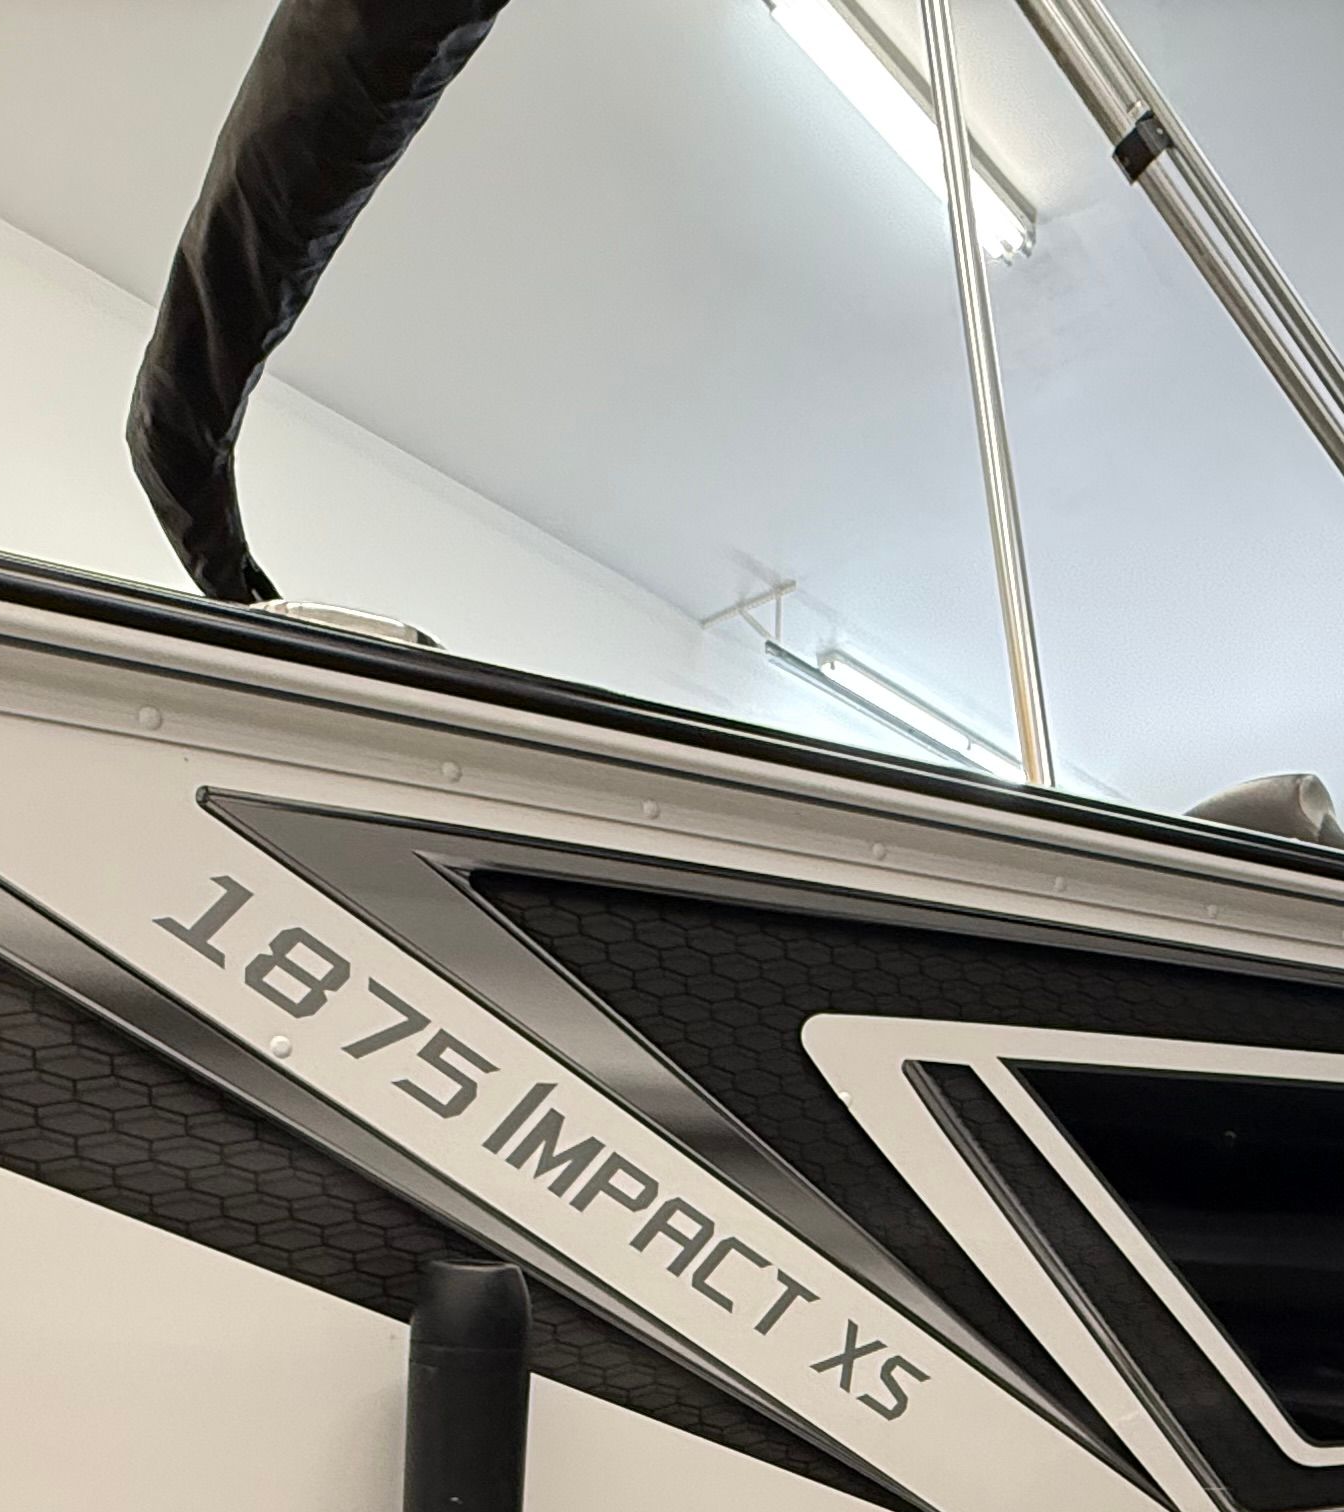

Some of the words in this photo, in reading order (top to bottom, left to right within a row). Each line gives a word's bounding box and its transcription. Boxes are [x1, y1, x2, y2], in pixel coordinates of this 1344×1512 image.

[152, 874, 500, 1120] 1875
[482, 1081, 821, 1336] IMPACT
[809, 1318, 932, 1422] XS
